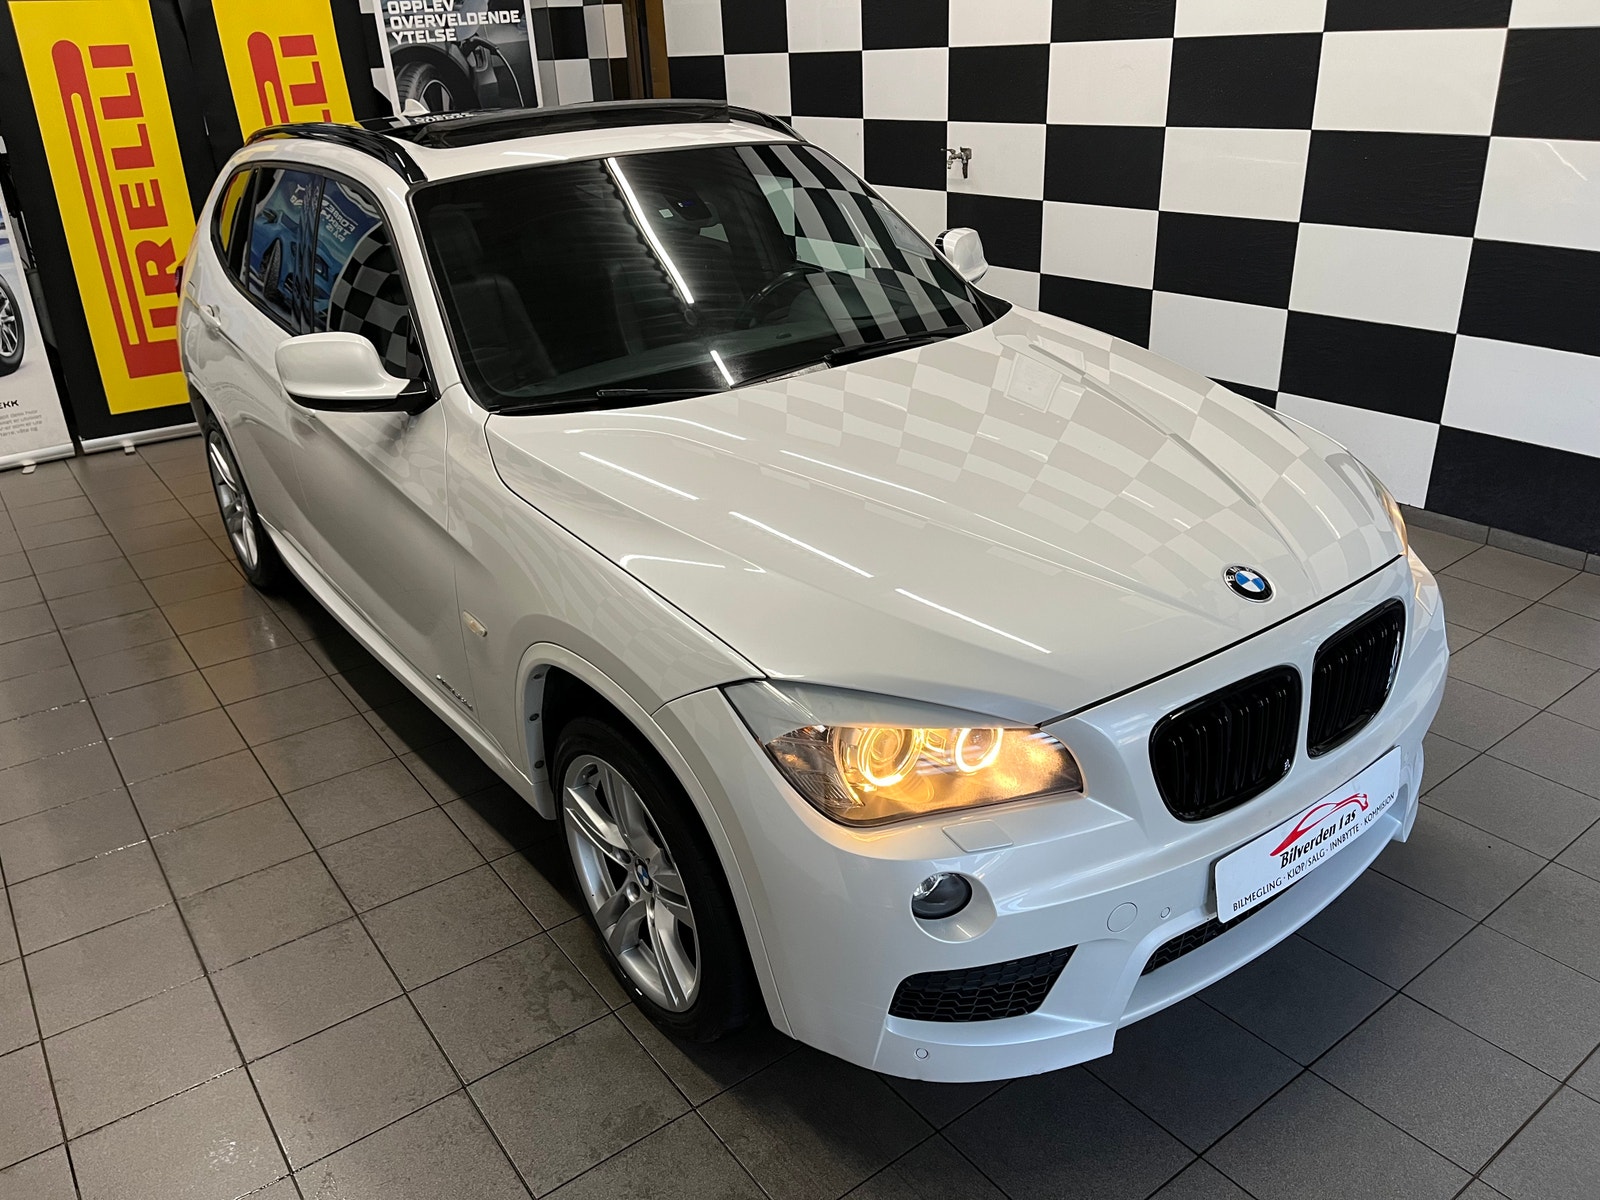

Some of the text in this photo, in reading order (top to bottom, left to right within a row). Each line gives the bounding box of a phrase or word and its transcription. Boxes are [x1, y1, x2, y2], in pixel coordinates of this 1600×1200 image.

[387, 0, 455, 15] OPPLEV
[390, 10, 521, 30] OVERVELDENDE
[392, 28, 457, 44] YTELSE
[52, 39, 182, 379] PIRELLI
[1280, 823, 1336, 869] Bilverden
[1232, 877, 1282, 912] BILMEGLING
[1329, 823, 1359, 852] INNBYTTE
